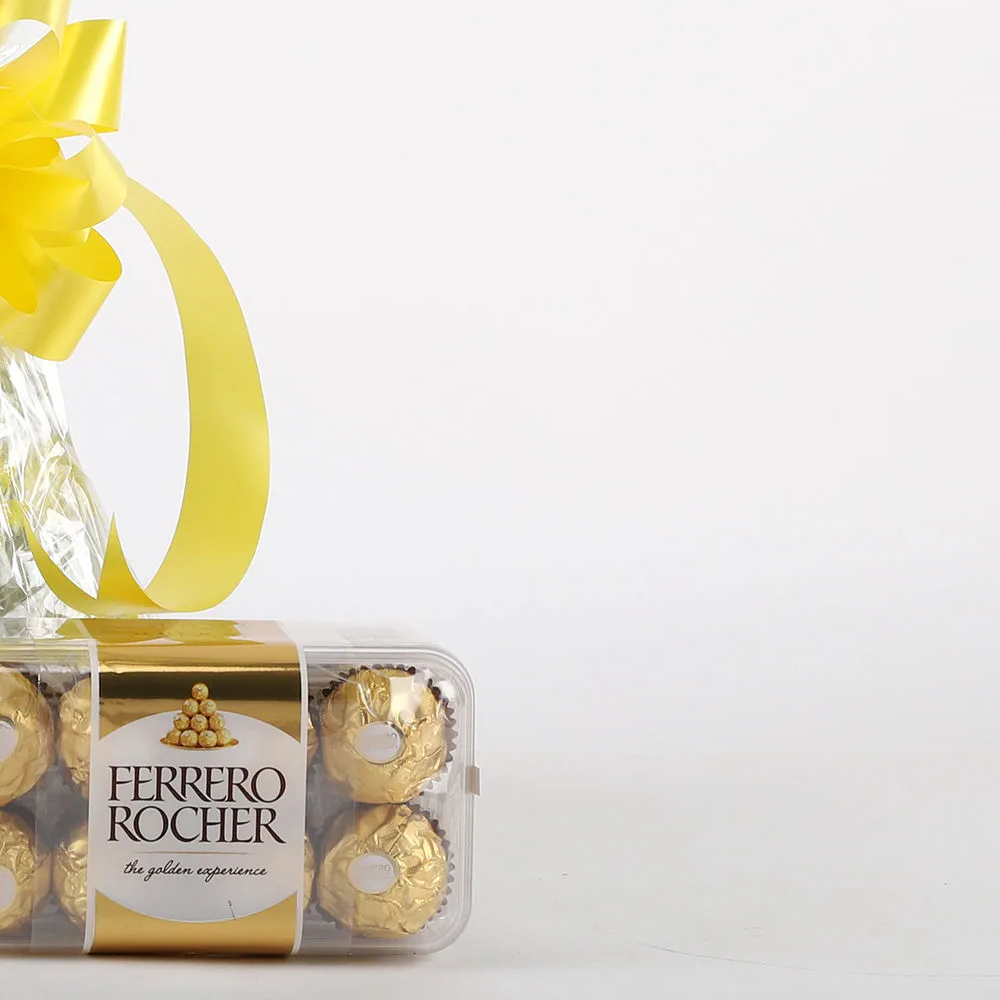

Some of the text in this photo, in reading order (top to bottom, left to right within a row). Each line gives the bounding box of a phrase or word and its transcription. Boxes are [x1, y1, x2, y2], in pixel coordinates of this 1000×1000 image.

[108, 765, 286, 803] FERRERO
[107, 805, 286, 844] ROCHER
[123, 860, 268, 883] the golden experience
